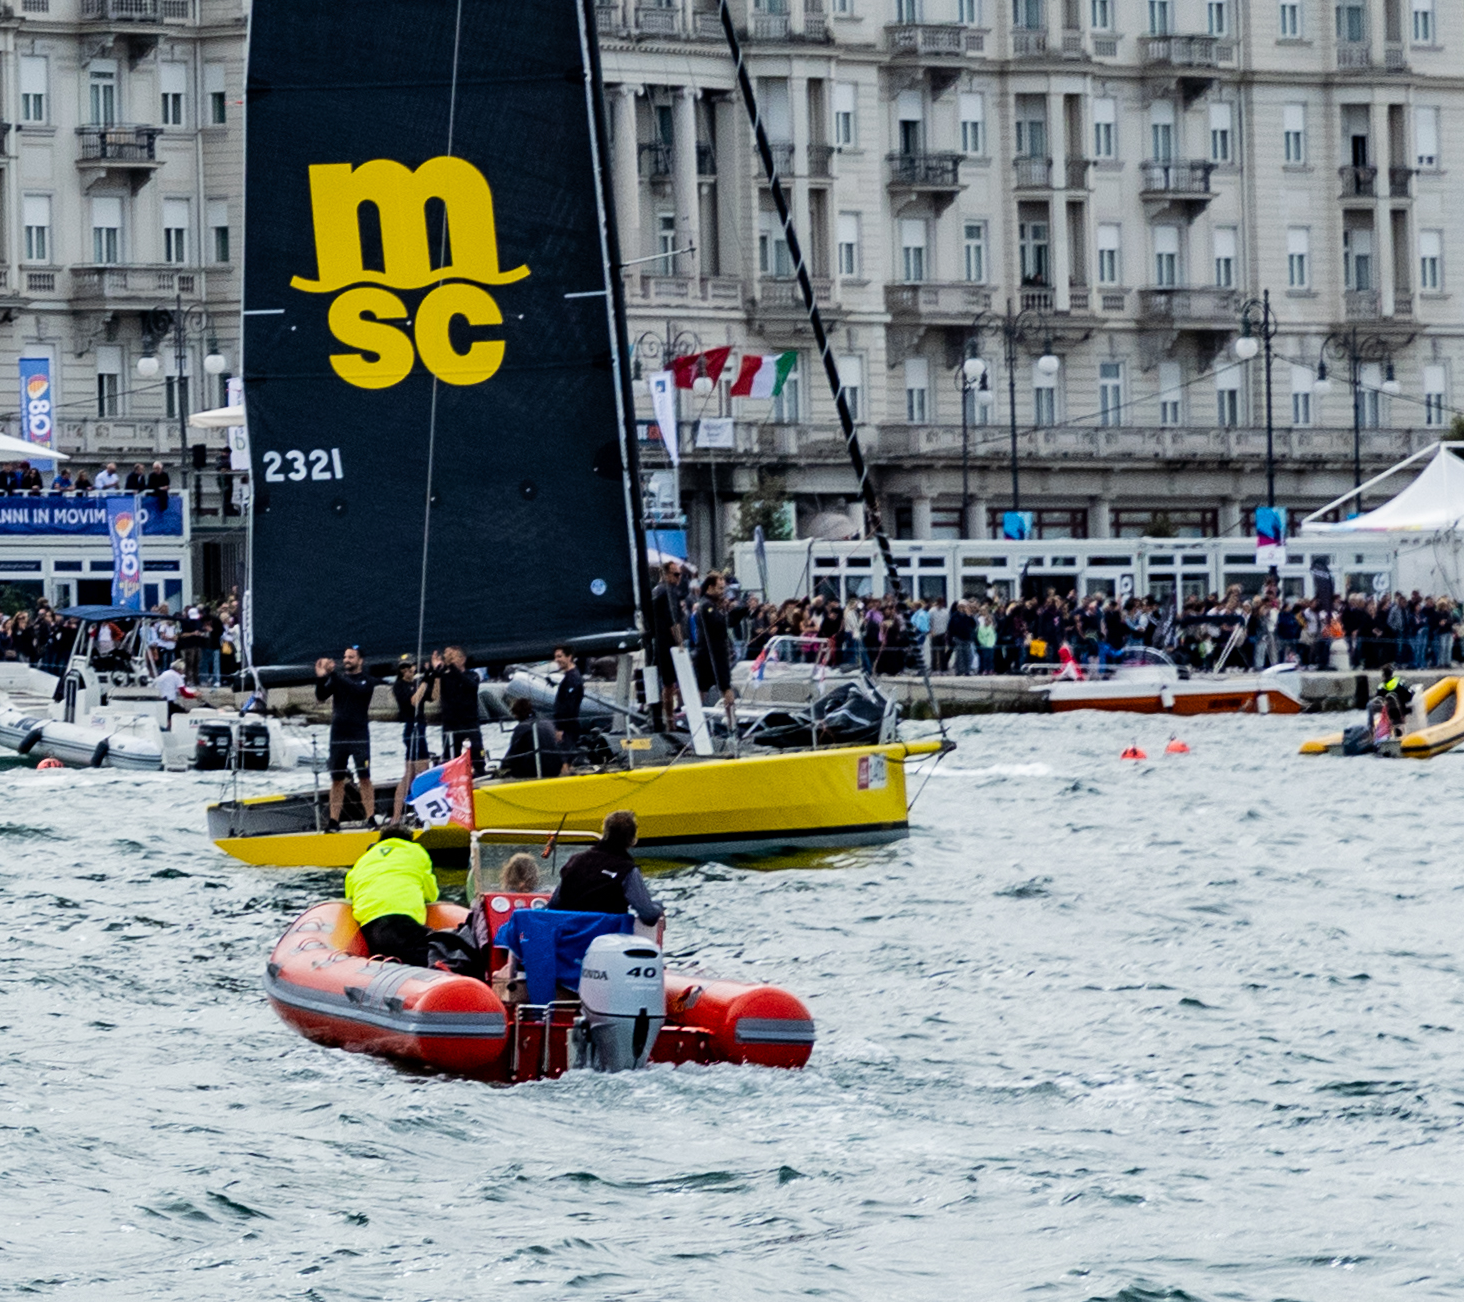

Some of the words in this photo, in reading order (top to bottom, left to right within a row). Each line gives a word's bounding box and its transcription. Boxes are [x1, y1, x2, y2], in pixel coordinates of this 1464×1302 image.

[262, 447, 345, 483] 2321
[33, 508, 49, 525] IN
[53, 507, 150, 526] MOVIMO
[581, 967, 609, 982] ONDA
[626, 965, 658, 980] 40
